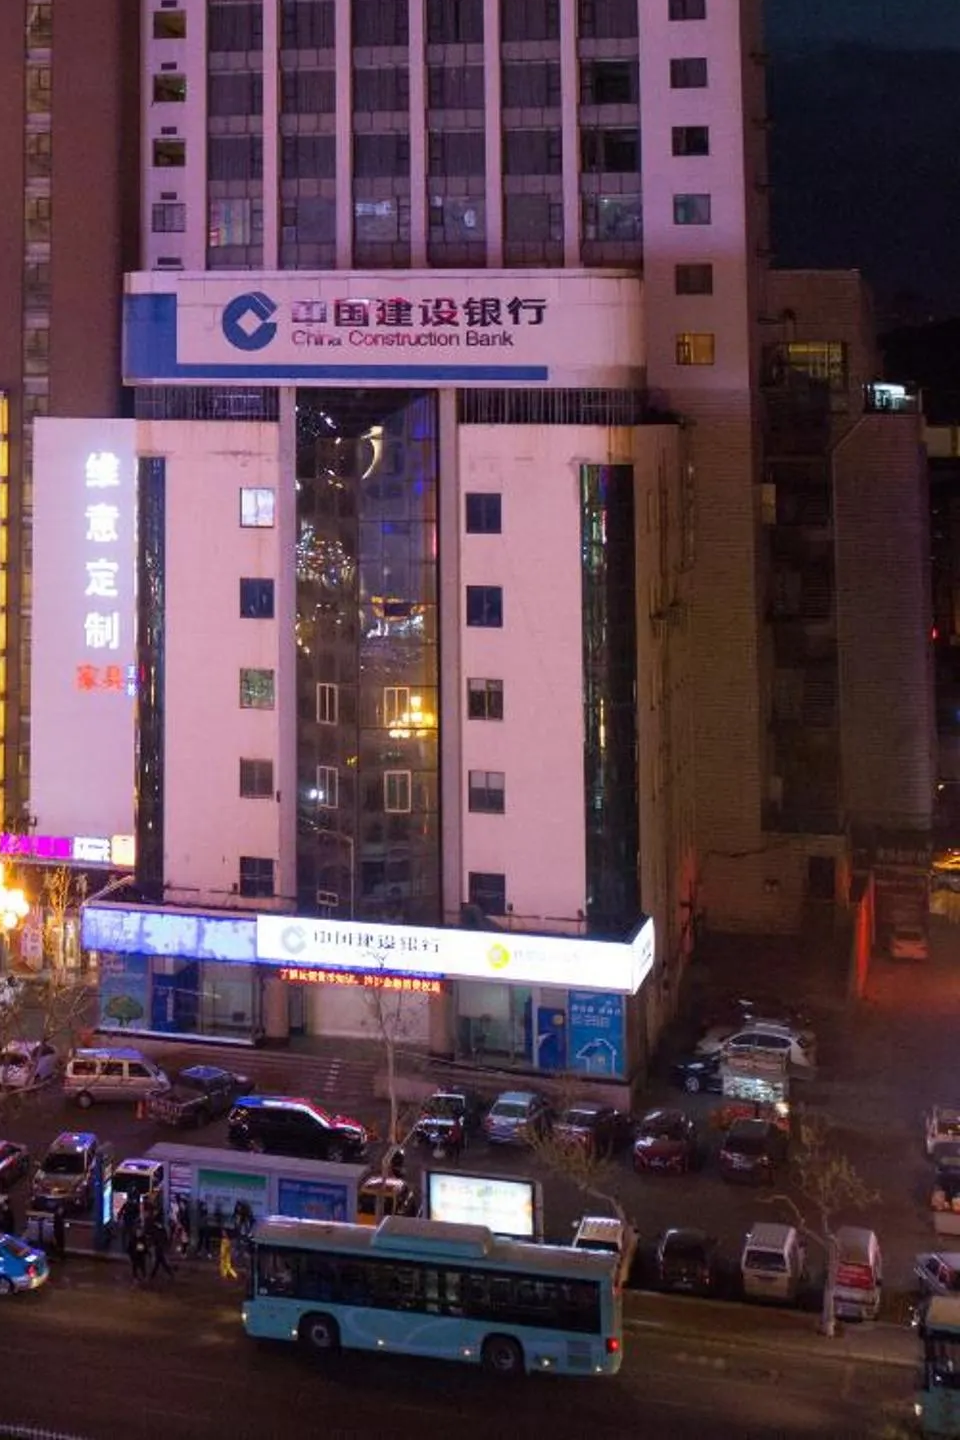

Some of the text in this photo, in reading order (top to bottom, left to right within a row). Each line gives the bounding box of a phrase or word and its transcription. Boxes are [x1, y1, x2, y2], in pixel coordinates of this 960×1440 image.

[291, 296, 547, 327] 中国建设银行
[291, 329, 514, 347] China Construction Bank
